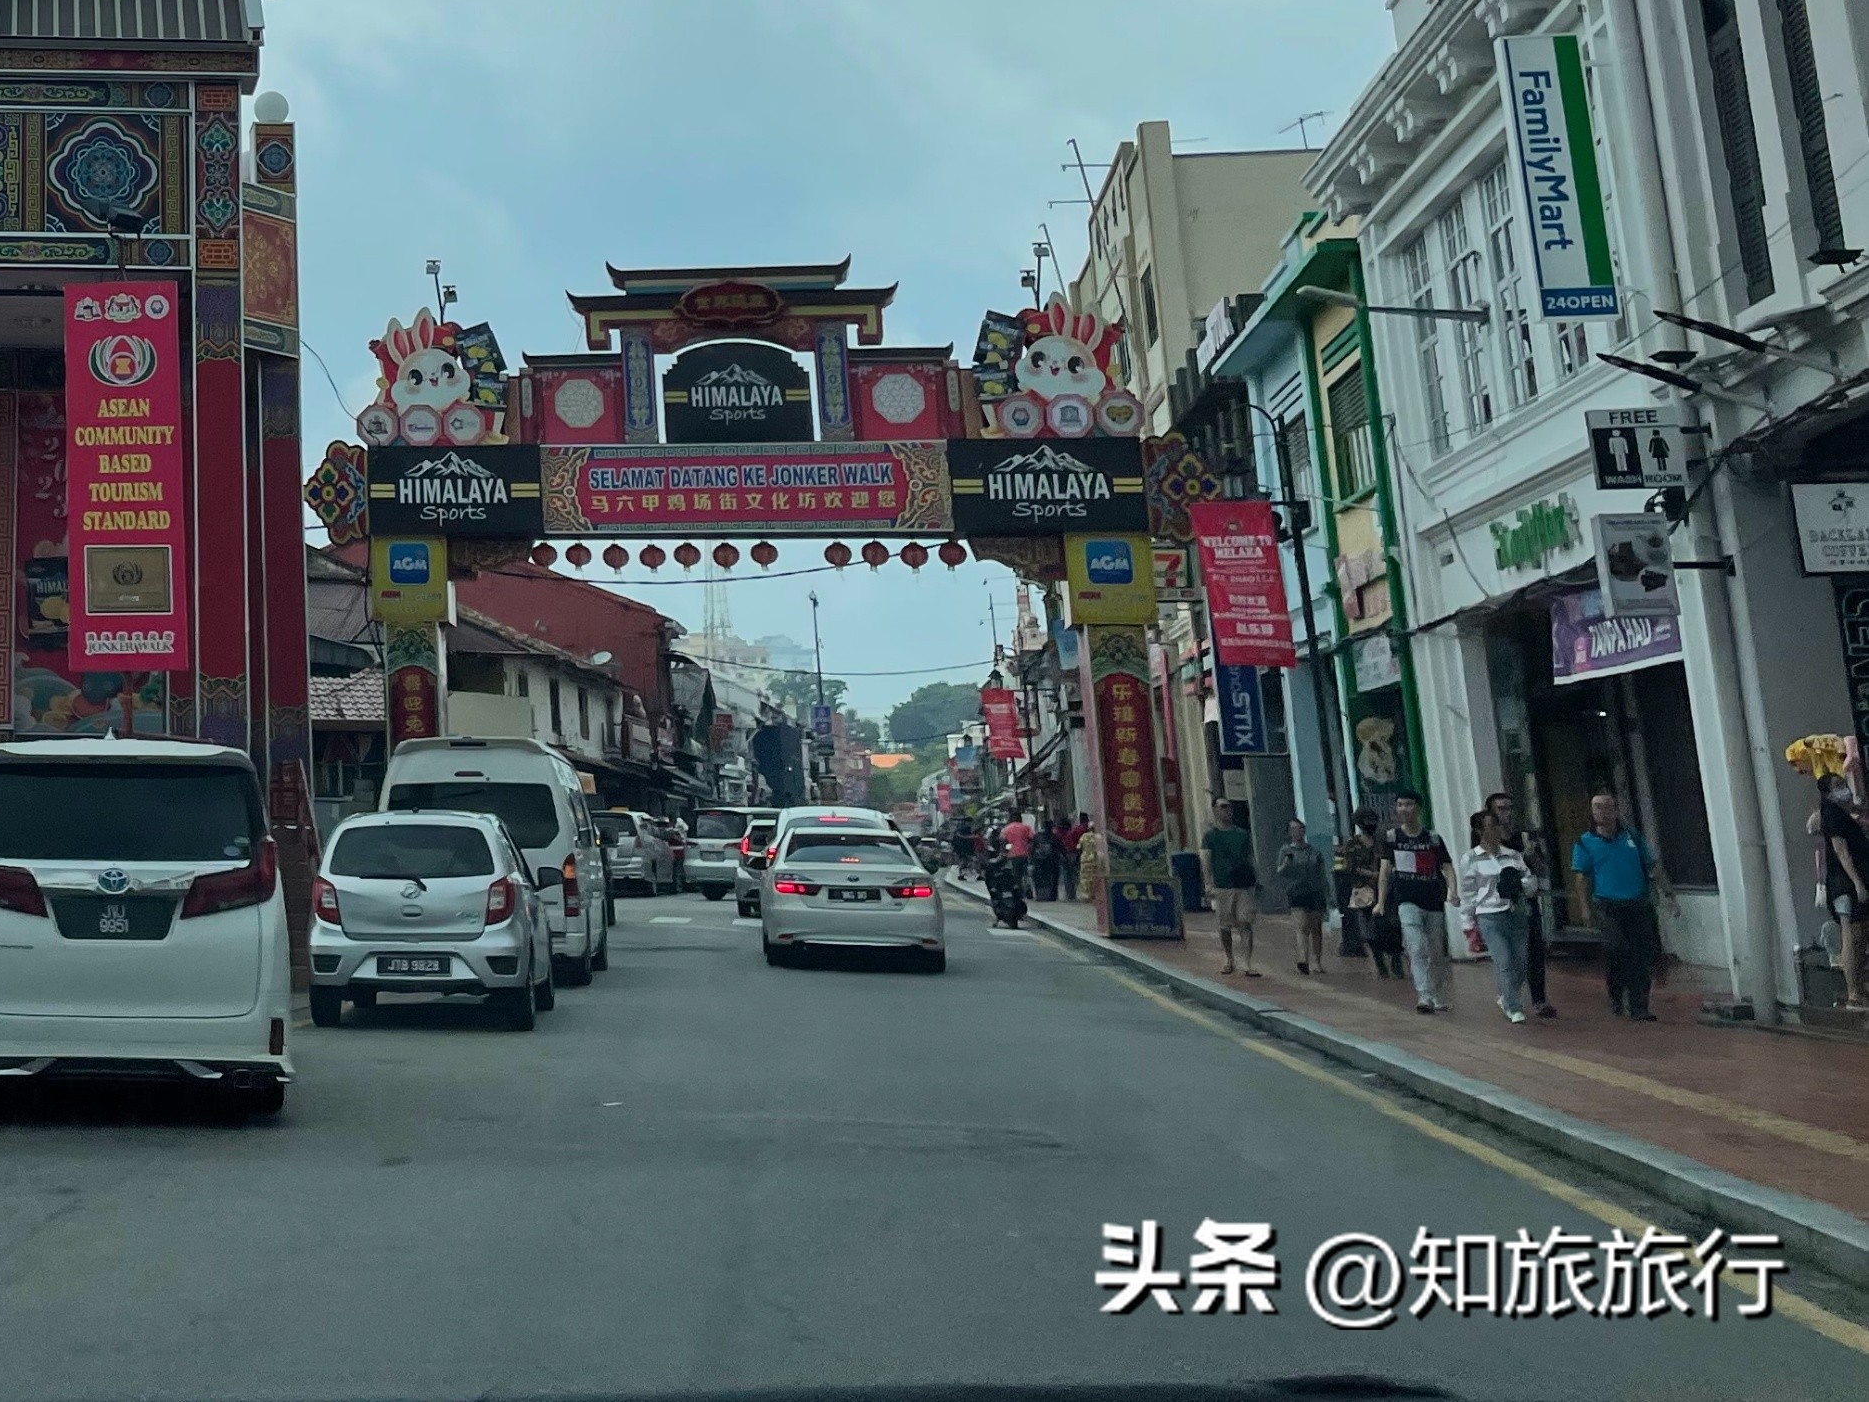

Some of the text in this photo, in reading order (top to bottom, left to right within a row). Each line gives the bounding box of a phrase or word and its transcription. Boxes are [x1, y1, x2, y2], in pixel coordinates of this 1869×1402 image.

[1517, 69, 1570, 250] FamilyMart
[1547, 294, 1615, 310] 24OPEN
[690, 385, 783, 408] HIMALAYA
[97, 398, 150, 418] ASEAN
[710, 406, 766, 425] Sports
[1608, 410, 1660, 425] FREE
[75, 425, 174, 447] COMMUNITY
[99, 455, 152, 474] BASED
[589, 462, 893, 490] SELAMAT DATANG KE JONKER WALK
[988, 472, 1111, 500] HIMALAYA
[1644, 473, 1683, 484] ROOM
[89, 482, 163, 502] TOURISM
[399, 478, 509, 504] HIMALAYA
[590, 491, 897, 513] 马六甲鸡场街文化坊欢迎您
[1012, 501, 1087, 522] Sports
[82, 510, 171, 532] STANDARD
[420, 504, 487, 527] Sports
[392, 556, 429, 571] AGM
[1091, 554, 1130, 571] AGM
[36, 579, 69, 595] HIMAL
[88, 641, 172, 653] JONKER WALK
